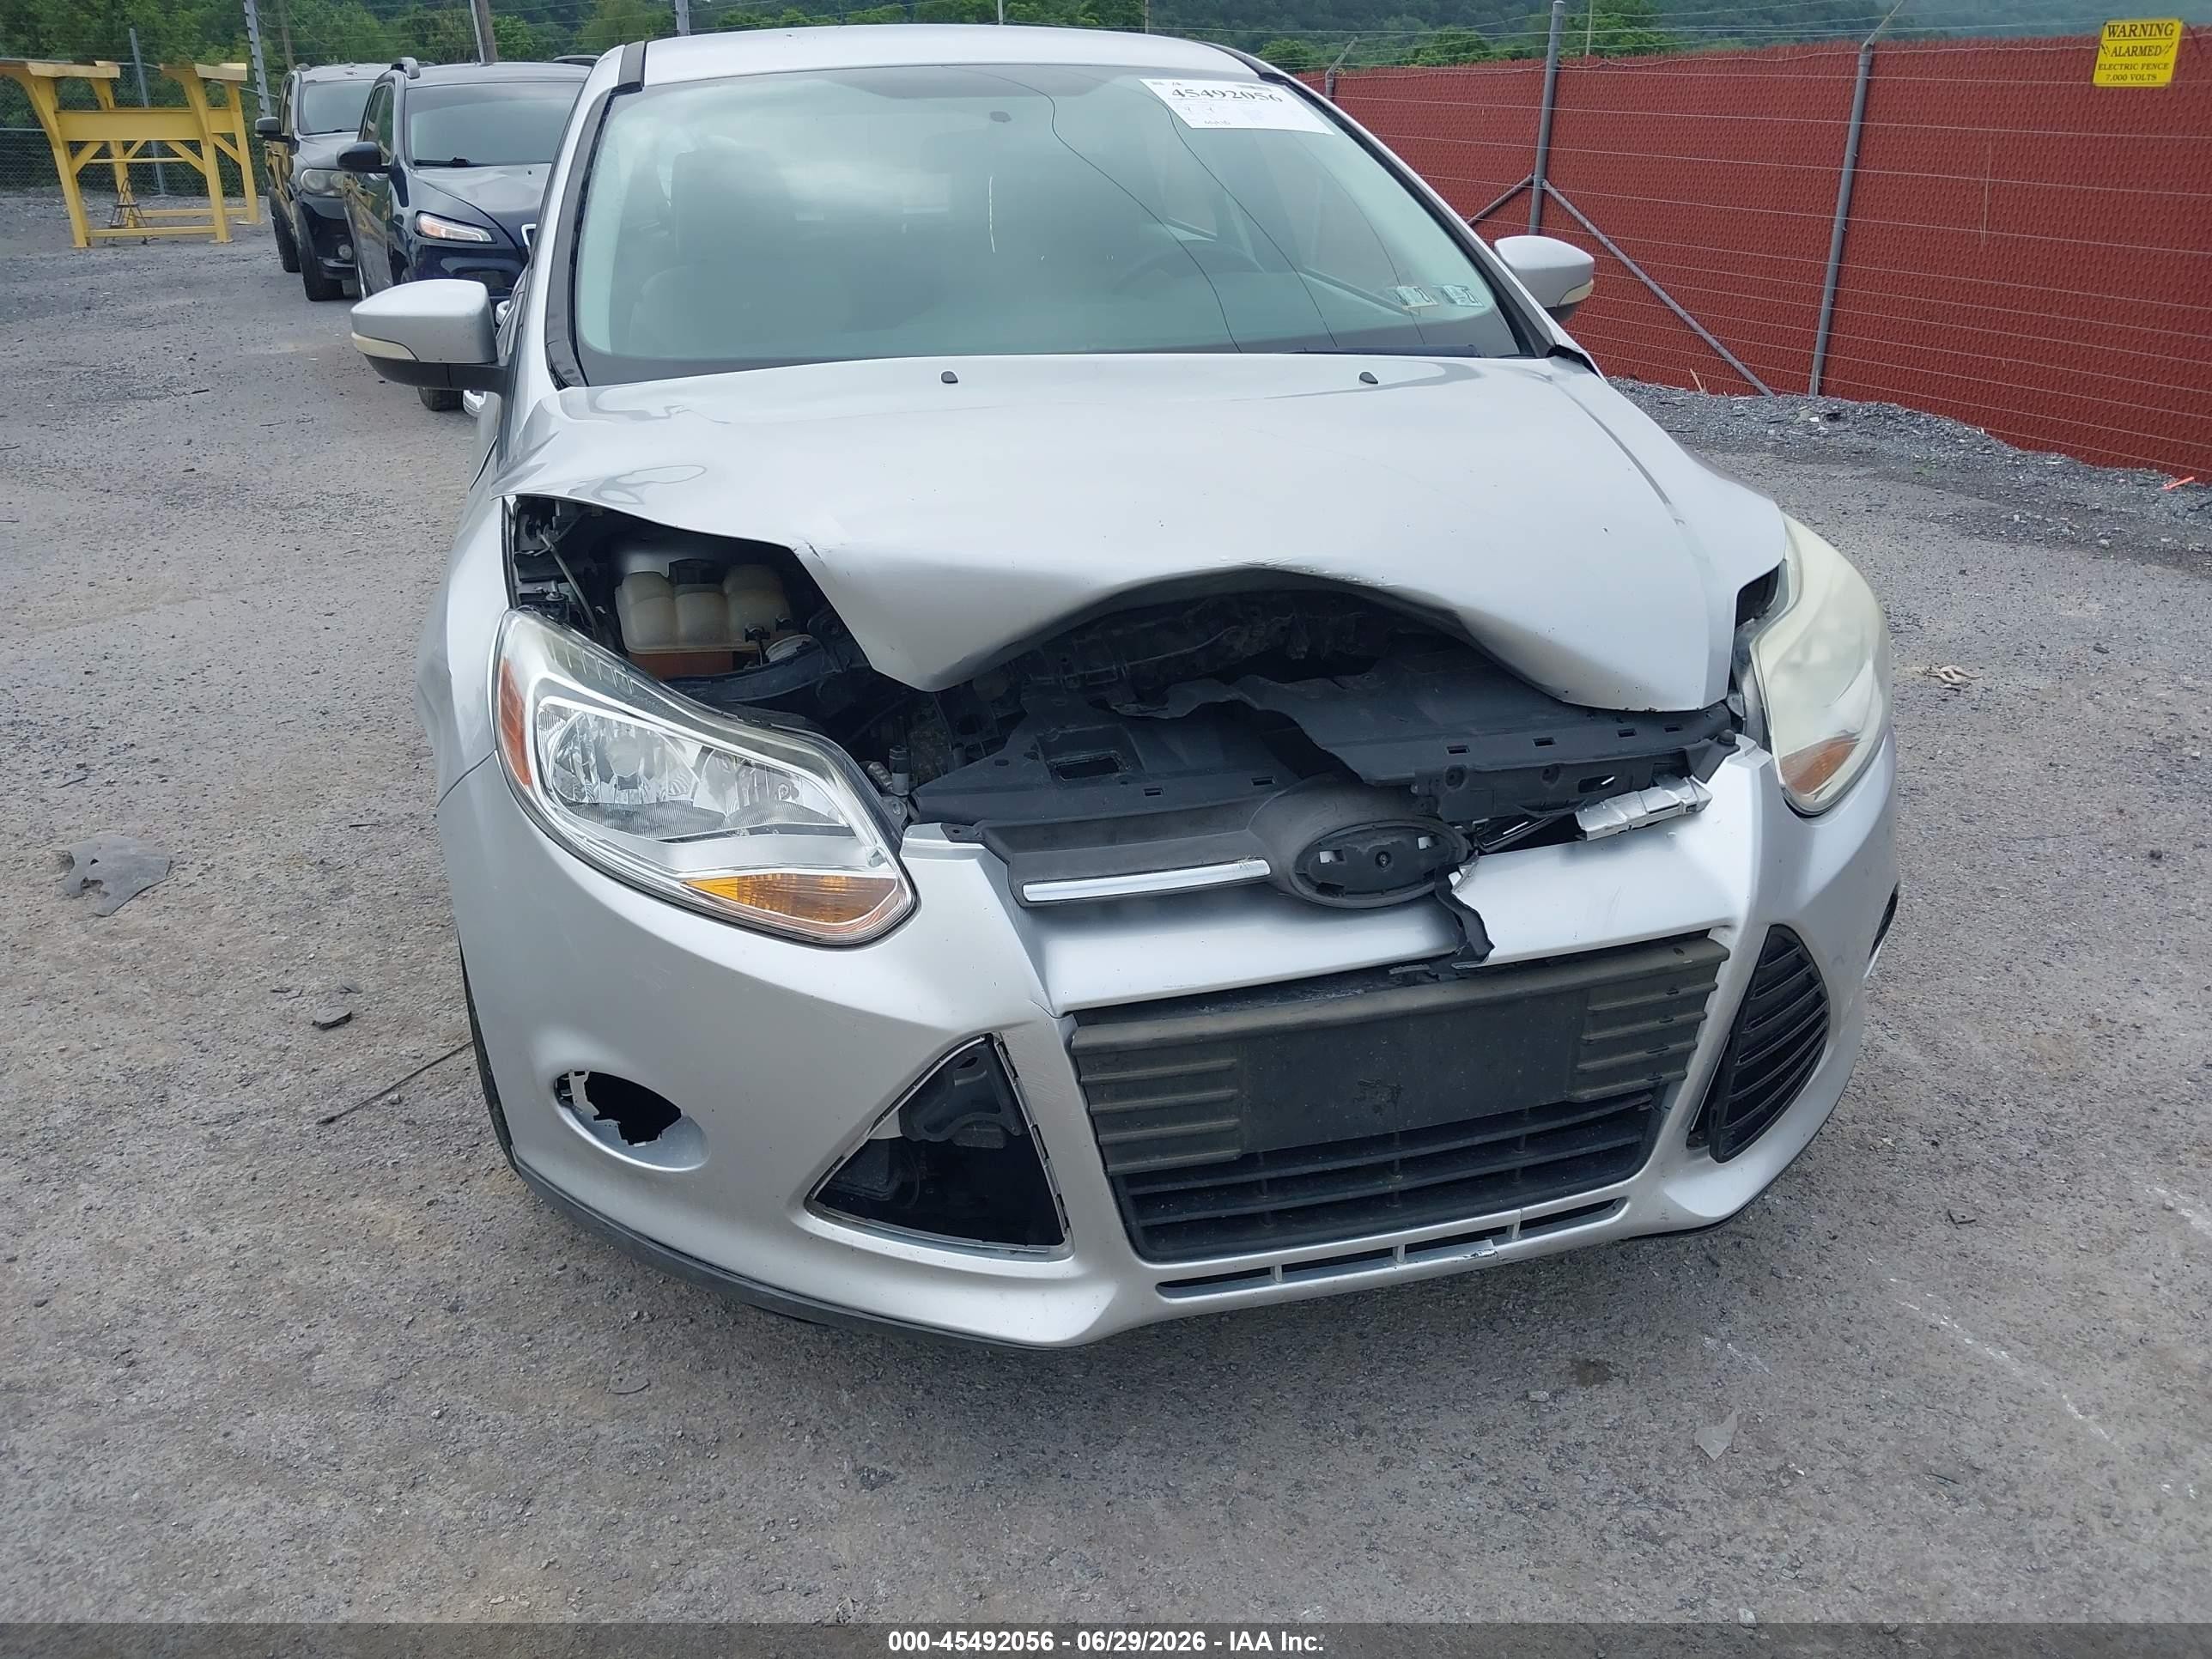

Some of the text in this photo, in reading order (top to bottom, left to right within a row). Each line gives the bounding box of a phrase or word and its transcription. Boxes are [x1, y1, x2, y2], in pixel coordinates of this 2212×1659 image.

[2107, 22, 2174, 38] WARNING
[2110, 45, 2162, 57] ALARMED
[2141, 62, 2170, 70] FENCE
[2130, 73, 2157, 82] VOLTS
[1171, 88, 1284, 102] 45492056
